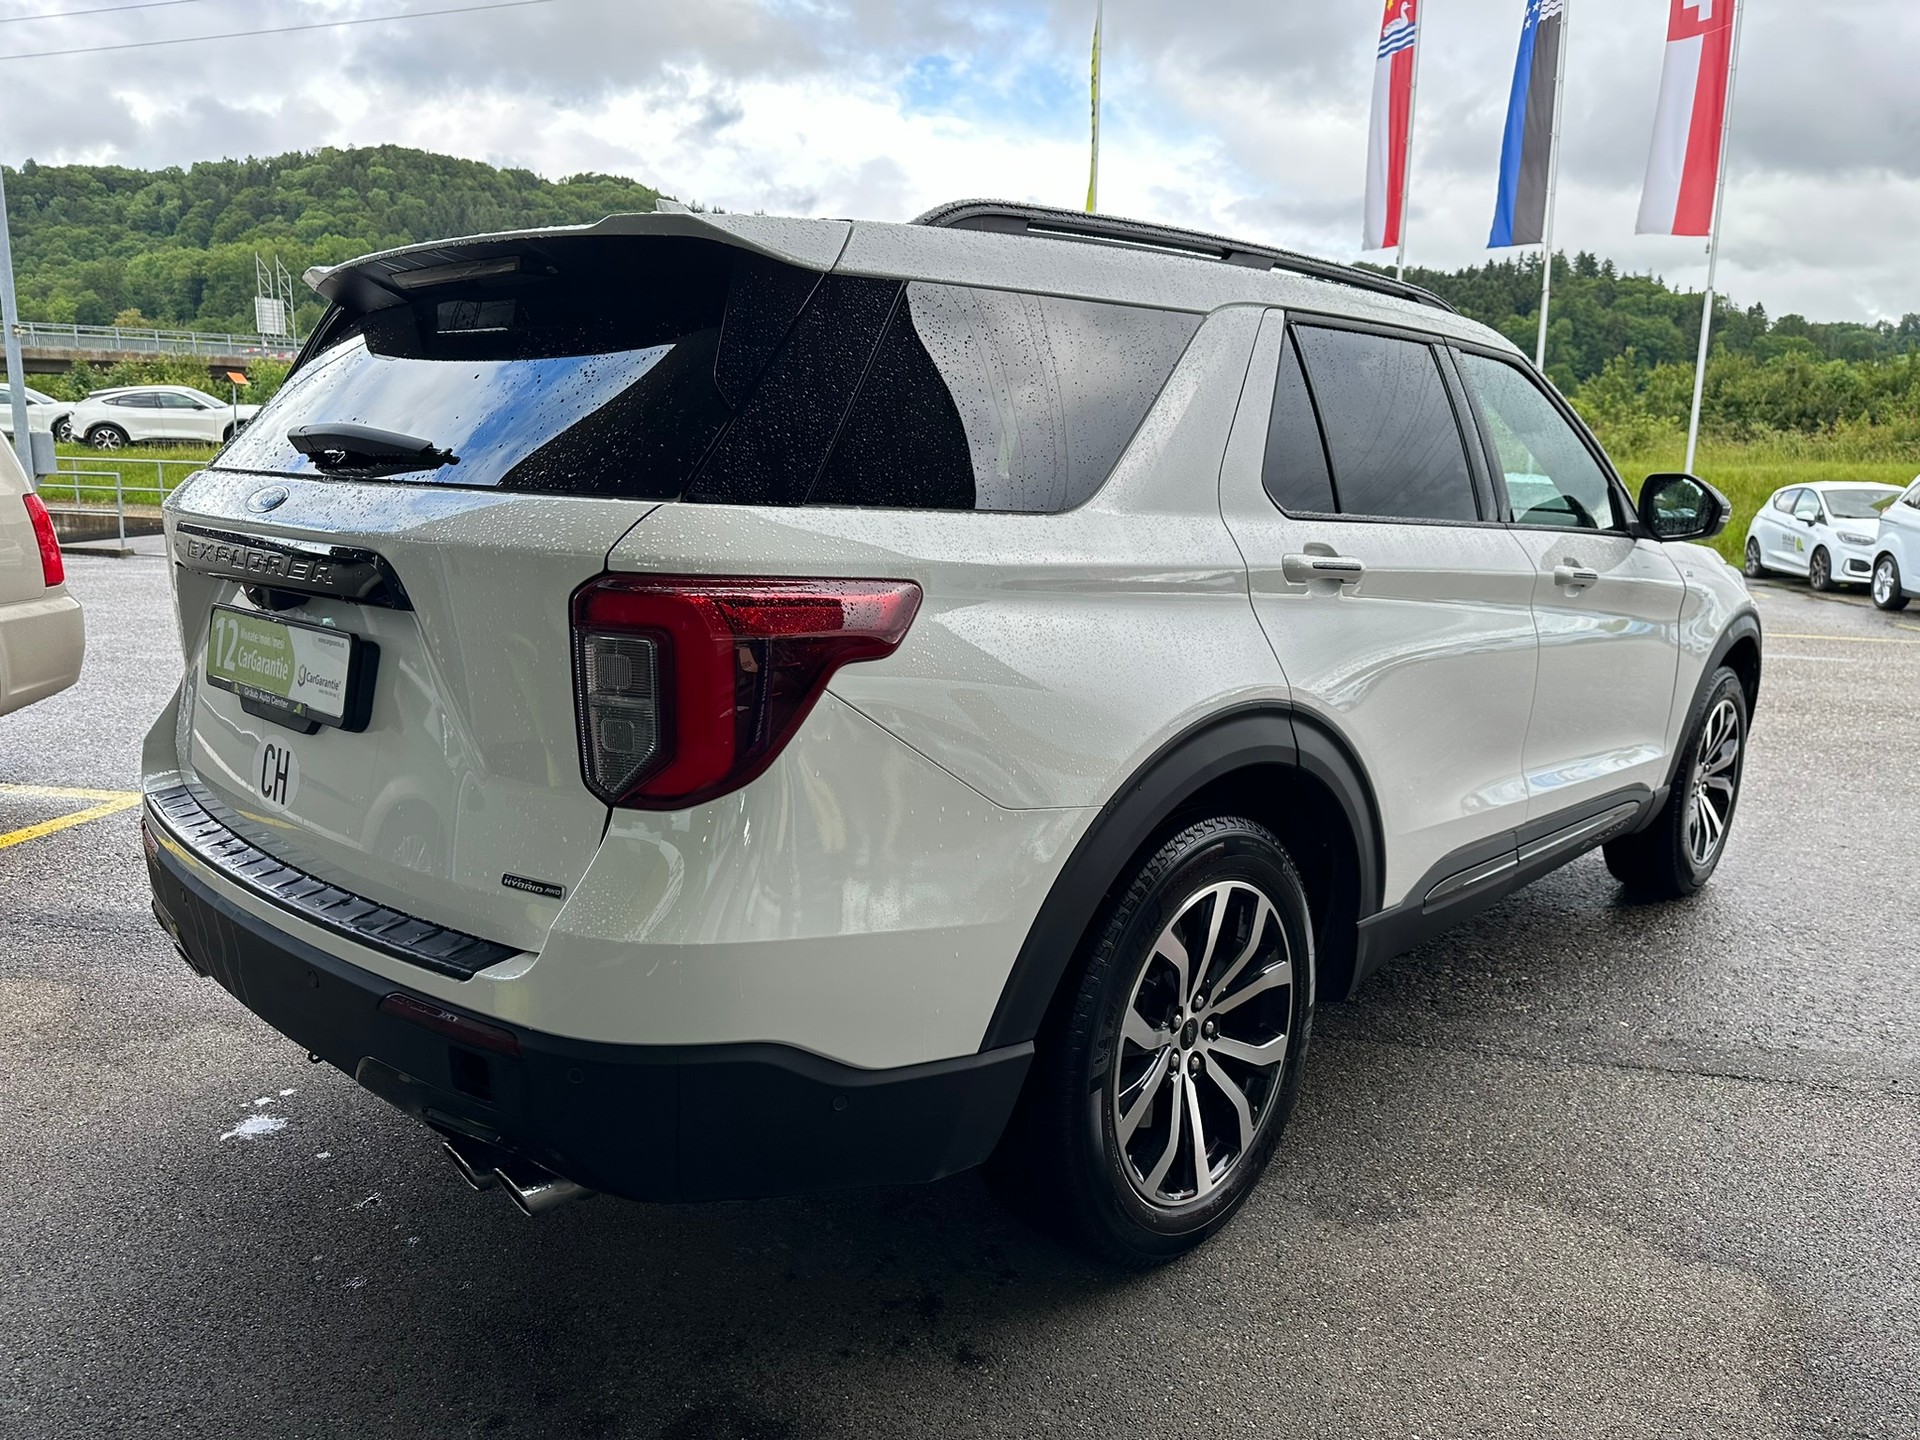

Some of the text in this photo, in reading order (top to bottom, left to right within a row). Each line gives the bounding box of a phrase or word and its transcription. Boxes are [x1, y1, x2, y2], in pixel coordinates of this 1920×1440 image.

[187, 540, 334, 584] EXPLORER
[216, 616, 238, 672] 12
[271, 696, 289, 709] Center
[261, 743, 290, 805] CH
[504, 878, 561, 896] HYBRID AWD
